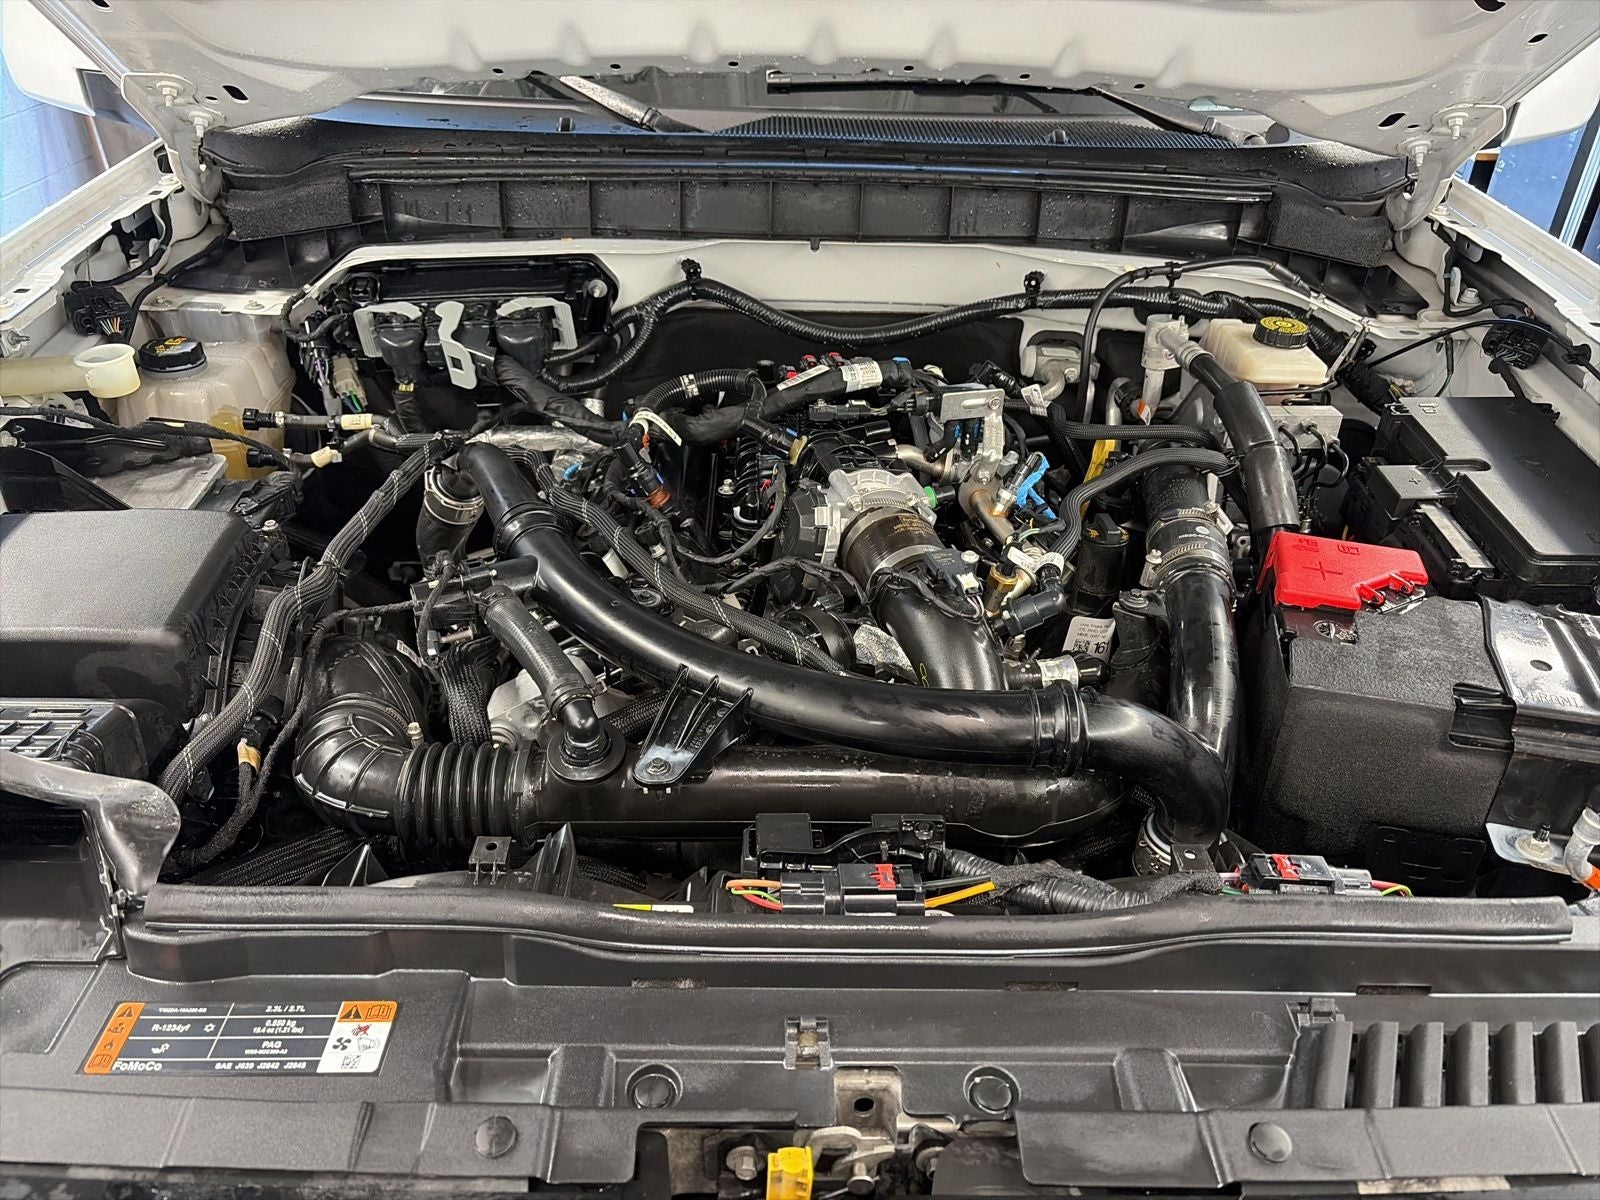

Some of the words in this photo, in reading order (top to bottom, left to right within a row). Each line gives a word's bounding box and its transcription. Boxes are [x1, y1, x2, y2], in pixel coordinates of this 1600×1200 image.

[265, 1005, 283, 1013] 2.3L
[288, 1005, 306, 1013] 2.7L
[286, 1019, 297, 1028] kg
[151, 1023, 192, 1033] R-1234yf
[261, 1040, 282, 1048] PAG
[112, 1061, 163, 1072] FoMoCo
[214, 1062, 234, 1070] SAE
